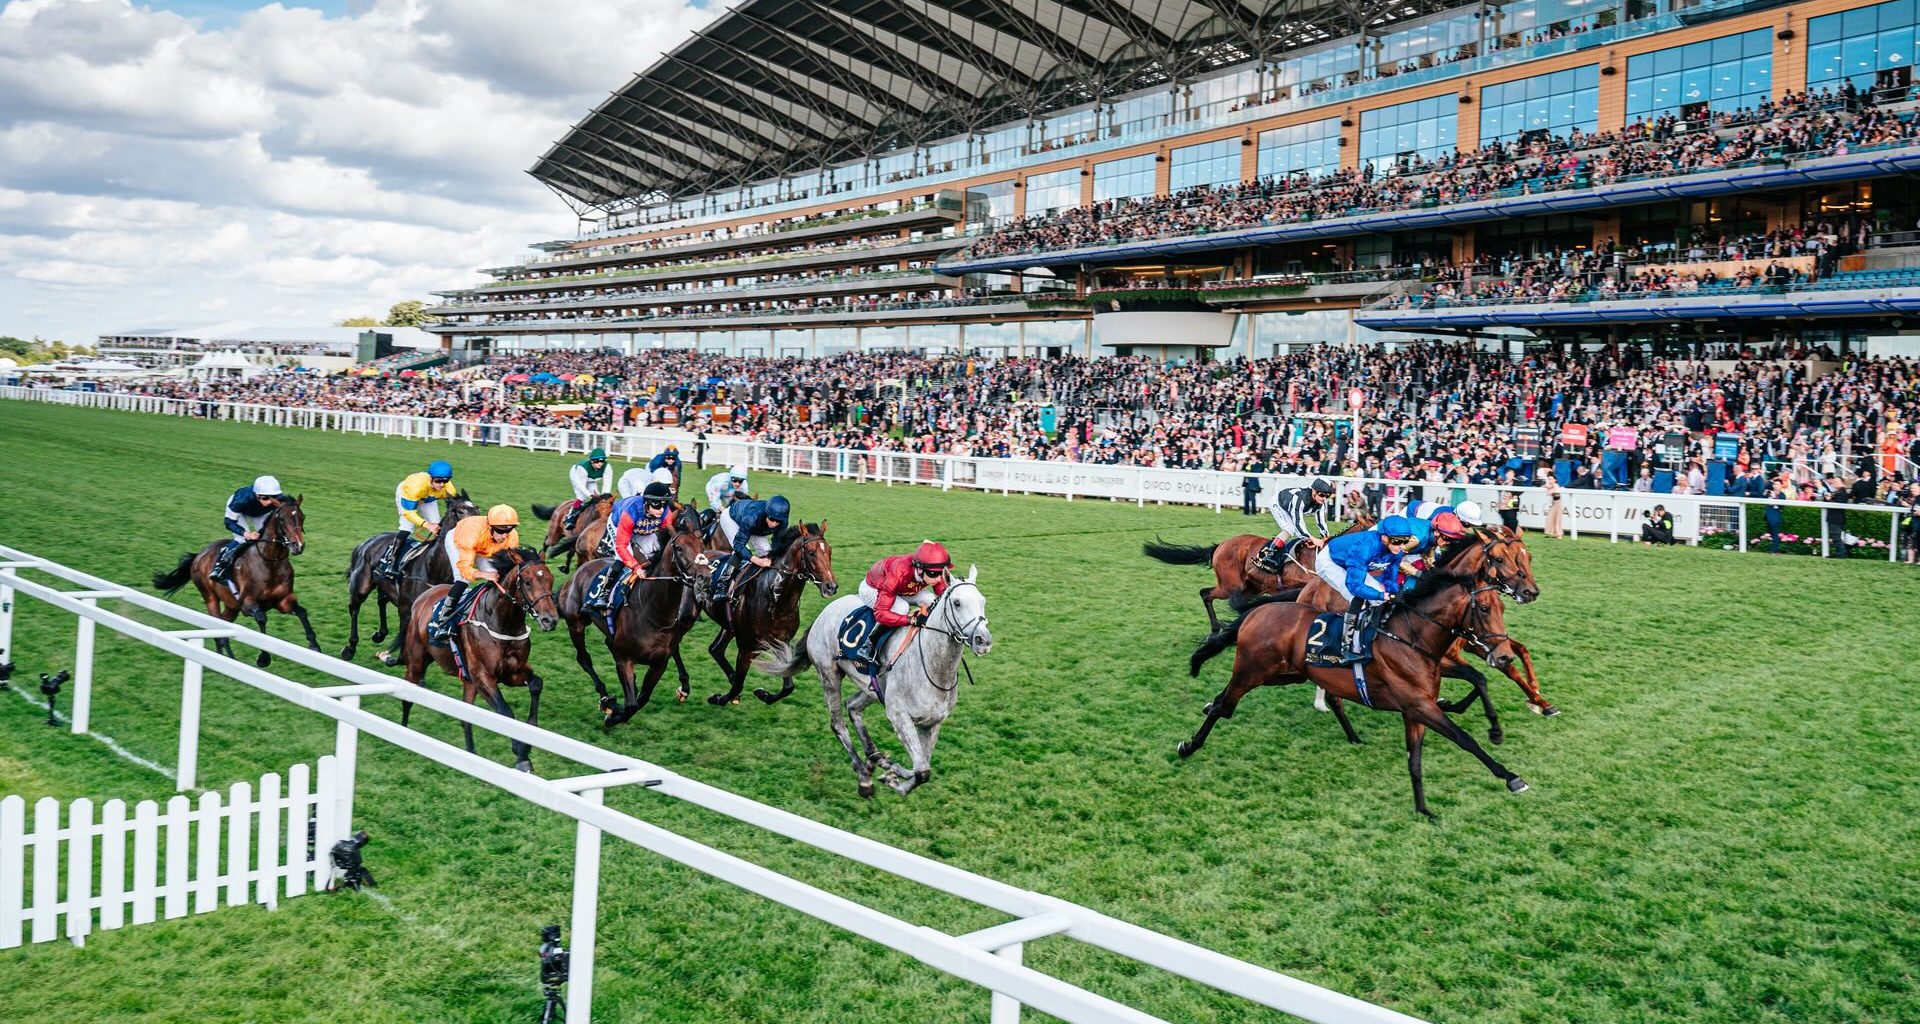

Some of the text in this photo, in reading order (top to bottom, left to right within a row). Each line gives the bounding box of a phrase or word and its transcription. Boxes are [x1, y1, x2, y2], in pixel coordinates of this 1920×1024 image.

[1015, 472, 1044, 484] ROYAL
[1177, 482, 1212, 495] ROYAL
[1490, 501, 1539, 516] RAL
[1307, 618, 1327, 646] 2
